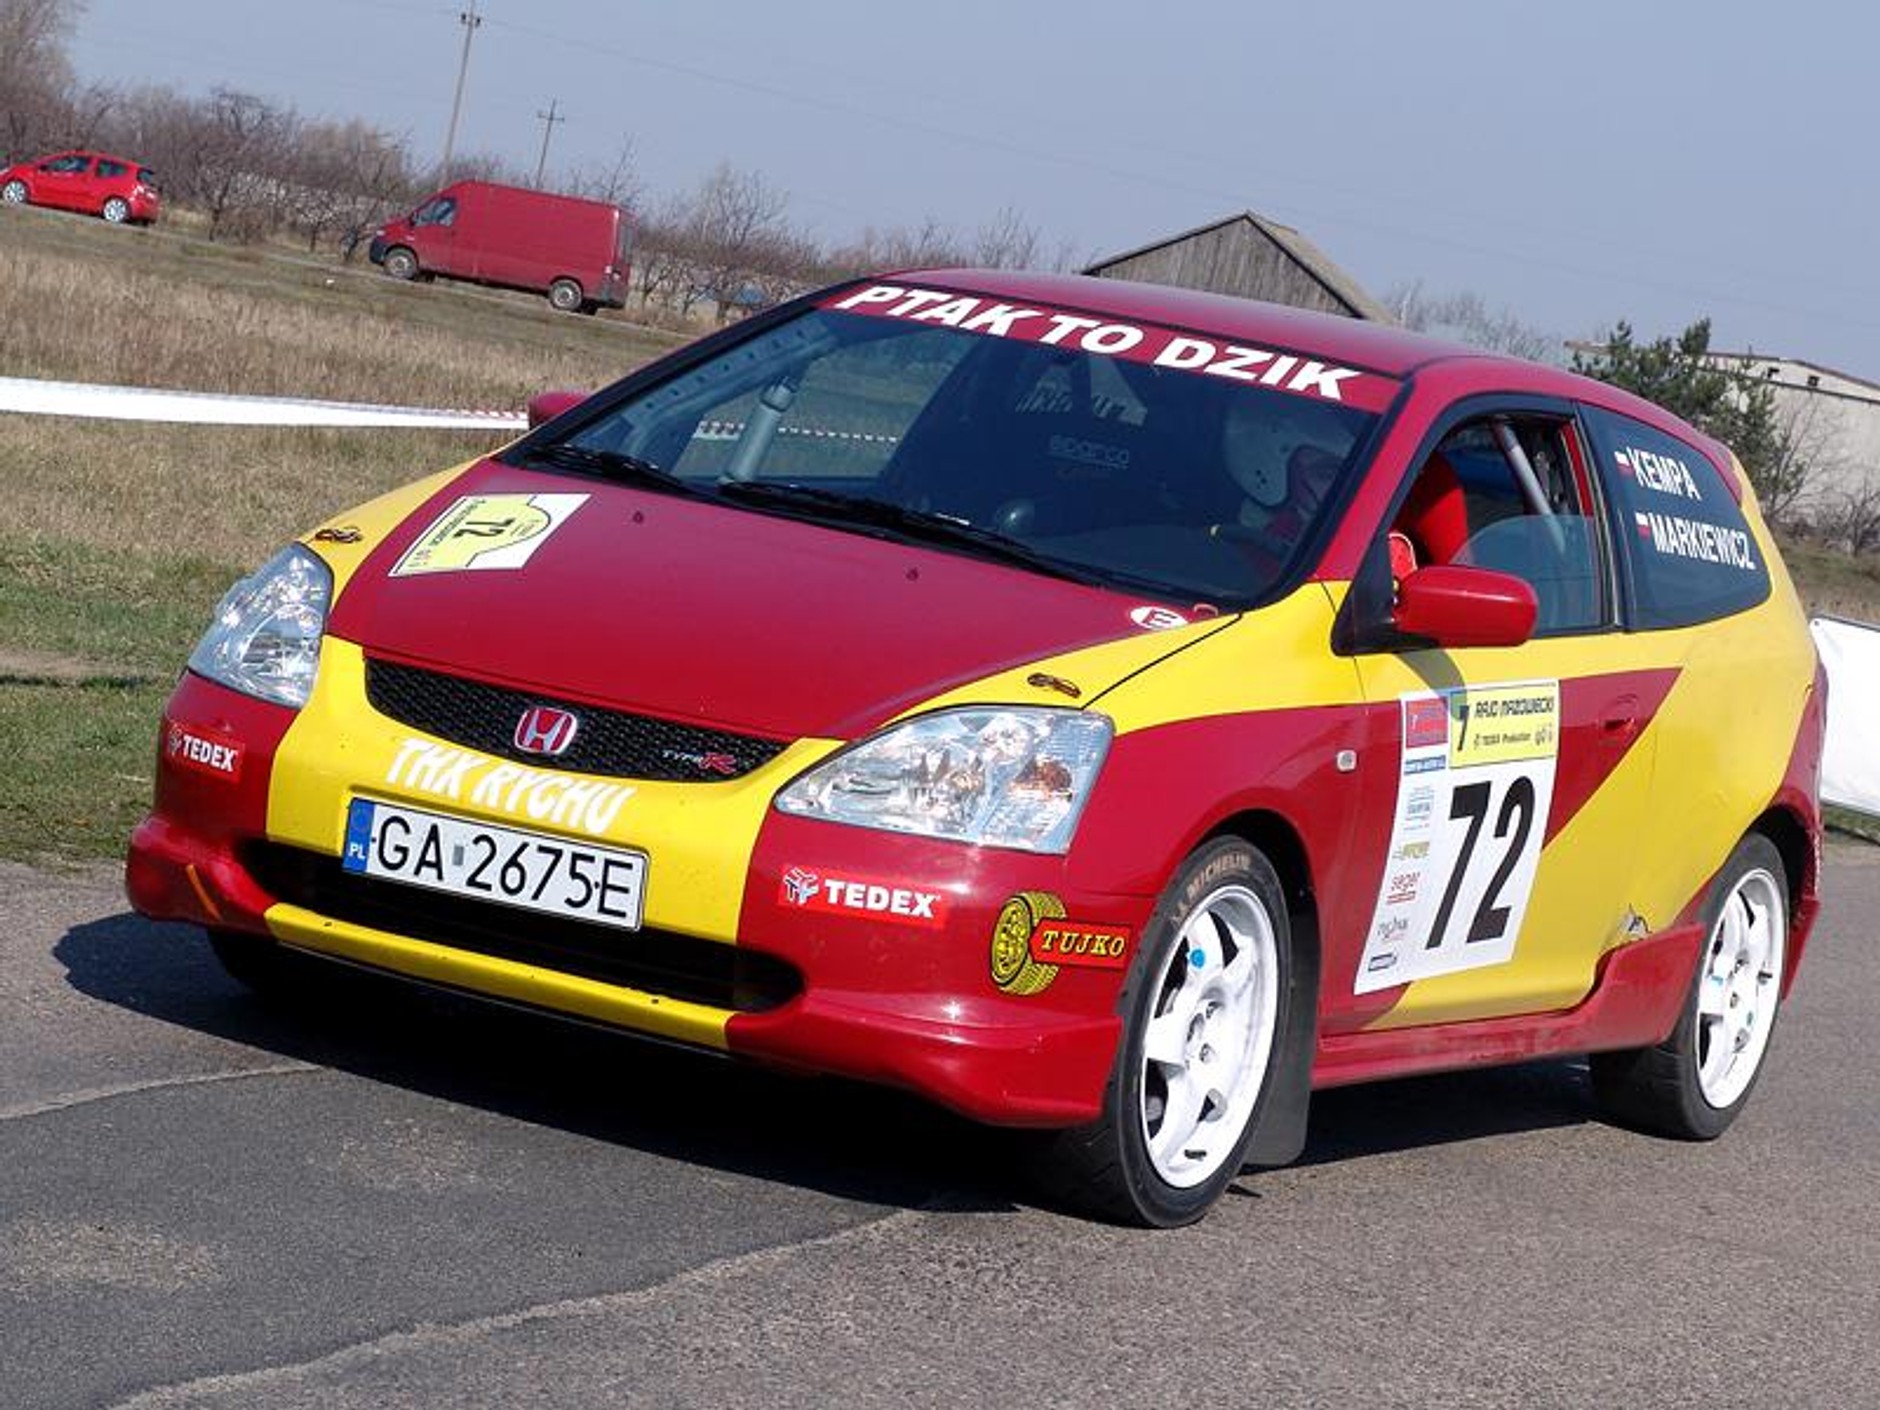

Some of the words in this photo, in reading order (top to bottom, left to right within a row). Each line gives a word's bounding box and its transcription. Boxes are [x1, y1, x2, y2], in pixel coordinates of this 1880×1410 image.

[835, 285, 1046, 338] PTAK
[1039, 313, 1144, 355] TO
[1154, 338, 1361, 400] DZIK
[1626, 447, 1702, 501] KEMPA
[453, 517, 517, 539] 72
[1647, 512, 1757, 570] MARKIEWICZ
[183, 734, 236, 772] TEDEX
[1457, 705, 1469, 752] 7
[472, 760, 638, 835] RYCHU
[348, 843, 366, 861] PL
[378, 815, 444, 882] GA
[465, 834, 634, 919] 2675E
[1425, 775, 1536, 951] 72
[824, 879, 936, 919] TEDEX
[1041, 928, 1126, 957] TUJKO
